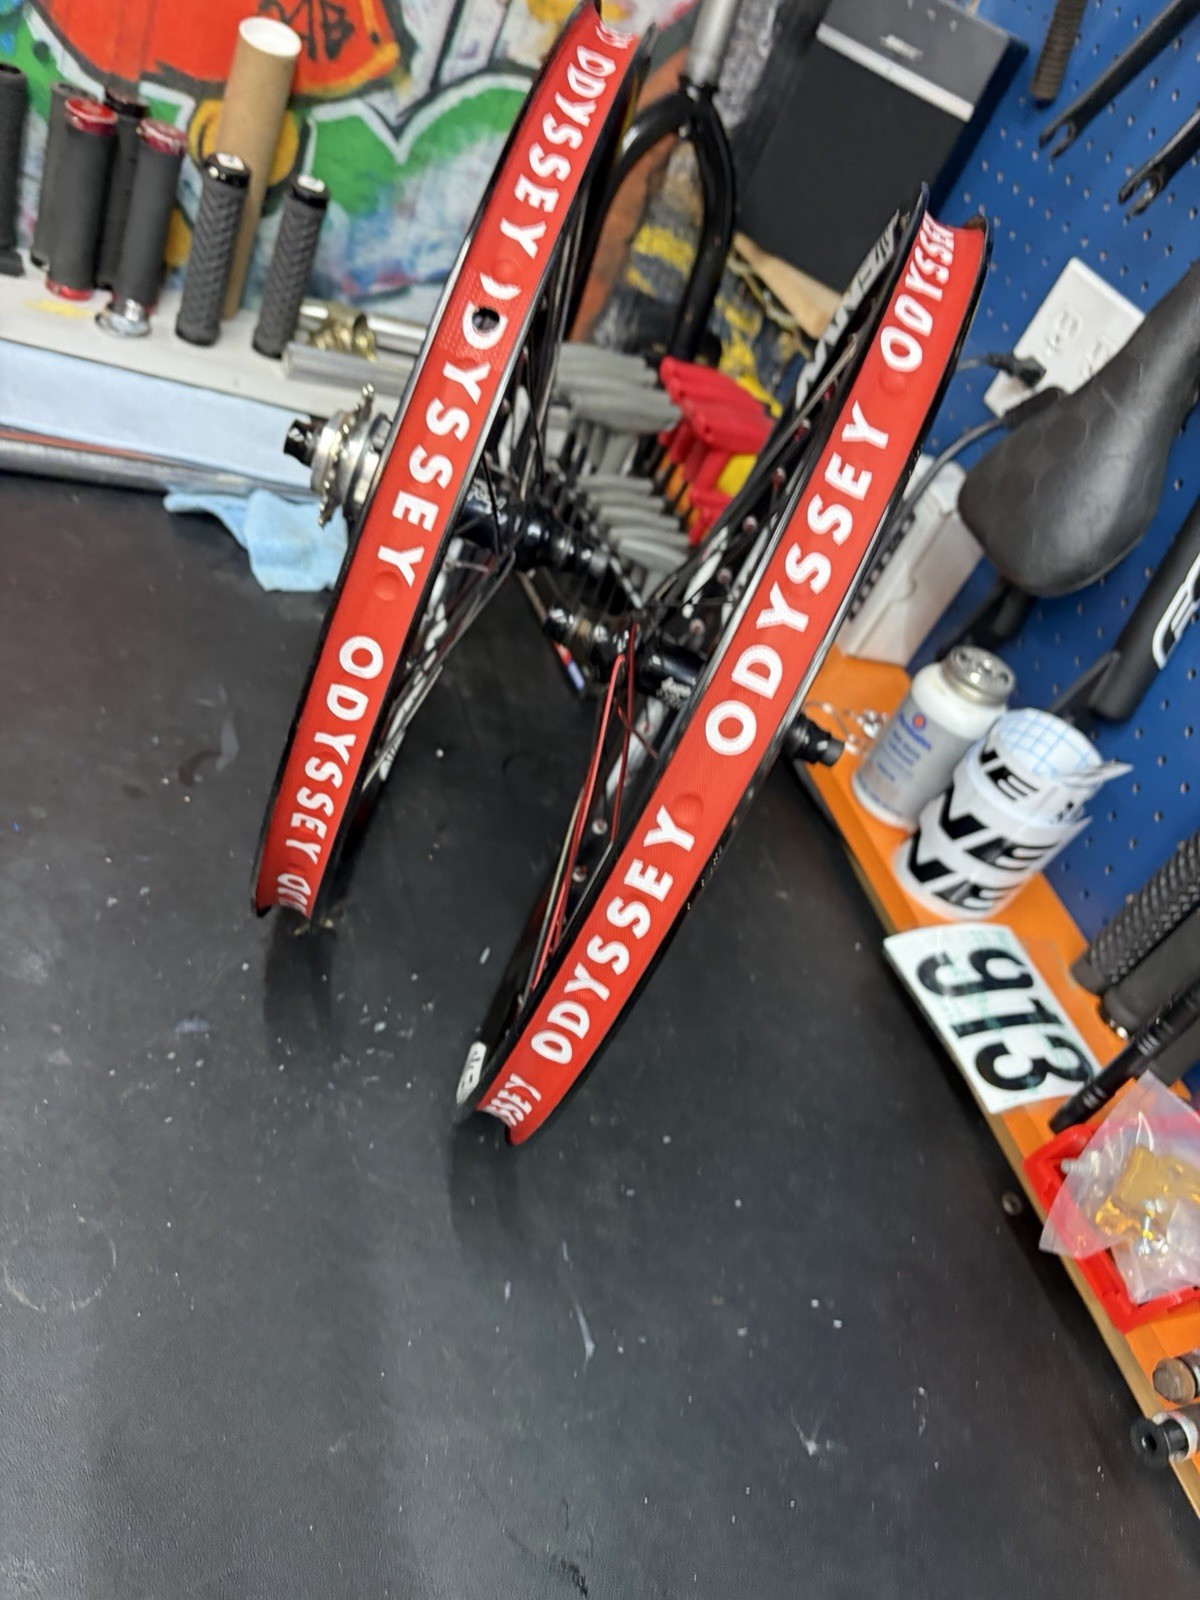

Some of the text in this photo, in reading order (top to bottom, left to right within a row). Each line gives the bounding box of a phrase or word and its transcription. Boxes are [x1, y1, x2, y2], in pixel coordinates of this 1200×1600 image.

[499, 44, 617, 260] ODYSSEY
[703, 399, 890, 757] ODYSSEY
[285, 633, 385, 865] ODYSSEY
[529, 804, 696, 1065] ODYSSEY
[918, 948, 1093, 1091] 913
